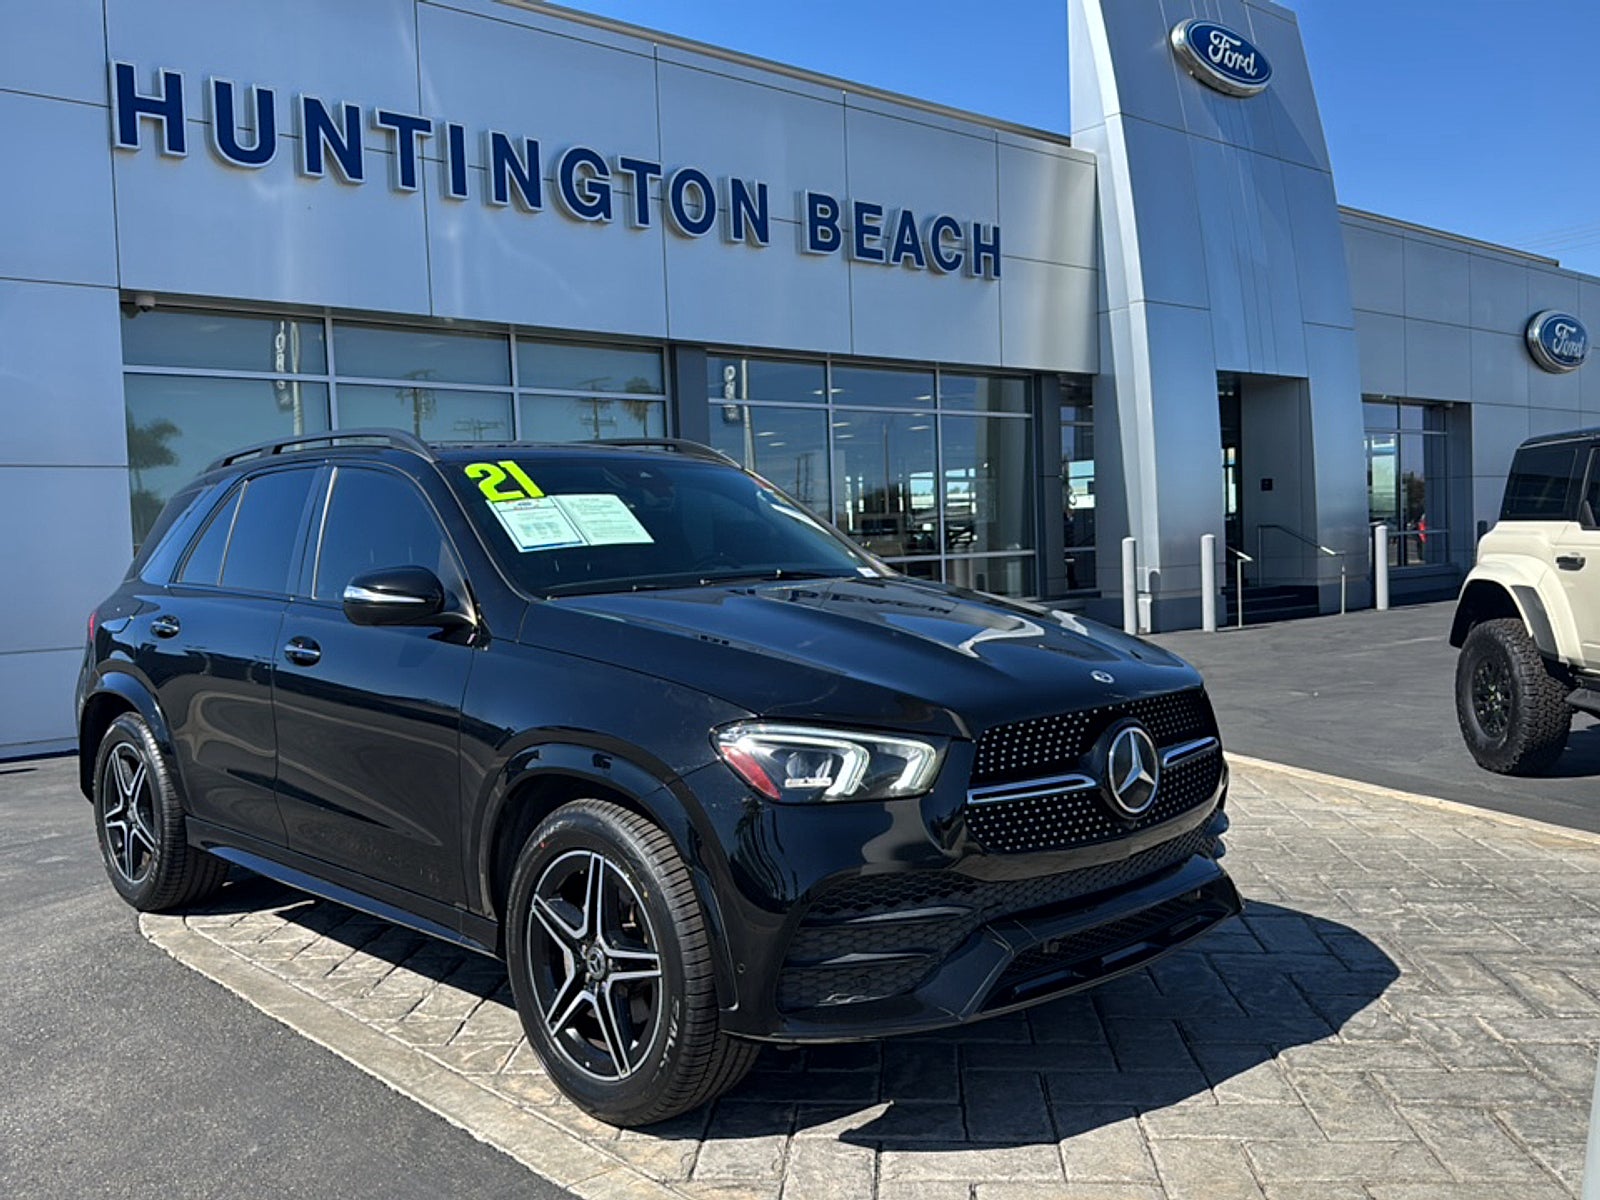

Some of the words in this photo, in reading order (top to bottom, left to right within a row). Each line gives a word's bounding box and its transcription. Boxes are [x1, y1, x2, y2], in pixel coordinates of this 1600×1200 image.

[1208, 30, 1258, 76] Ford
[111, 60, 769, 247] HUNTINGTON
[805, 190, 1001, 279] BEACH
[1553, 323, 1585, 358] Ford
[464, 460, 545, 502] 21
